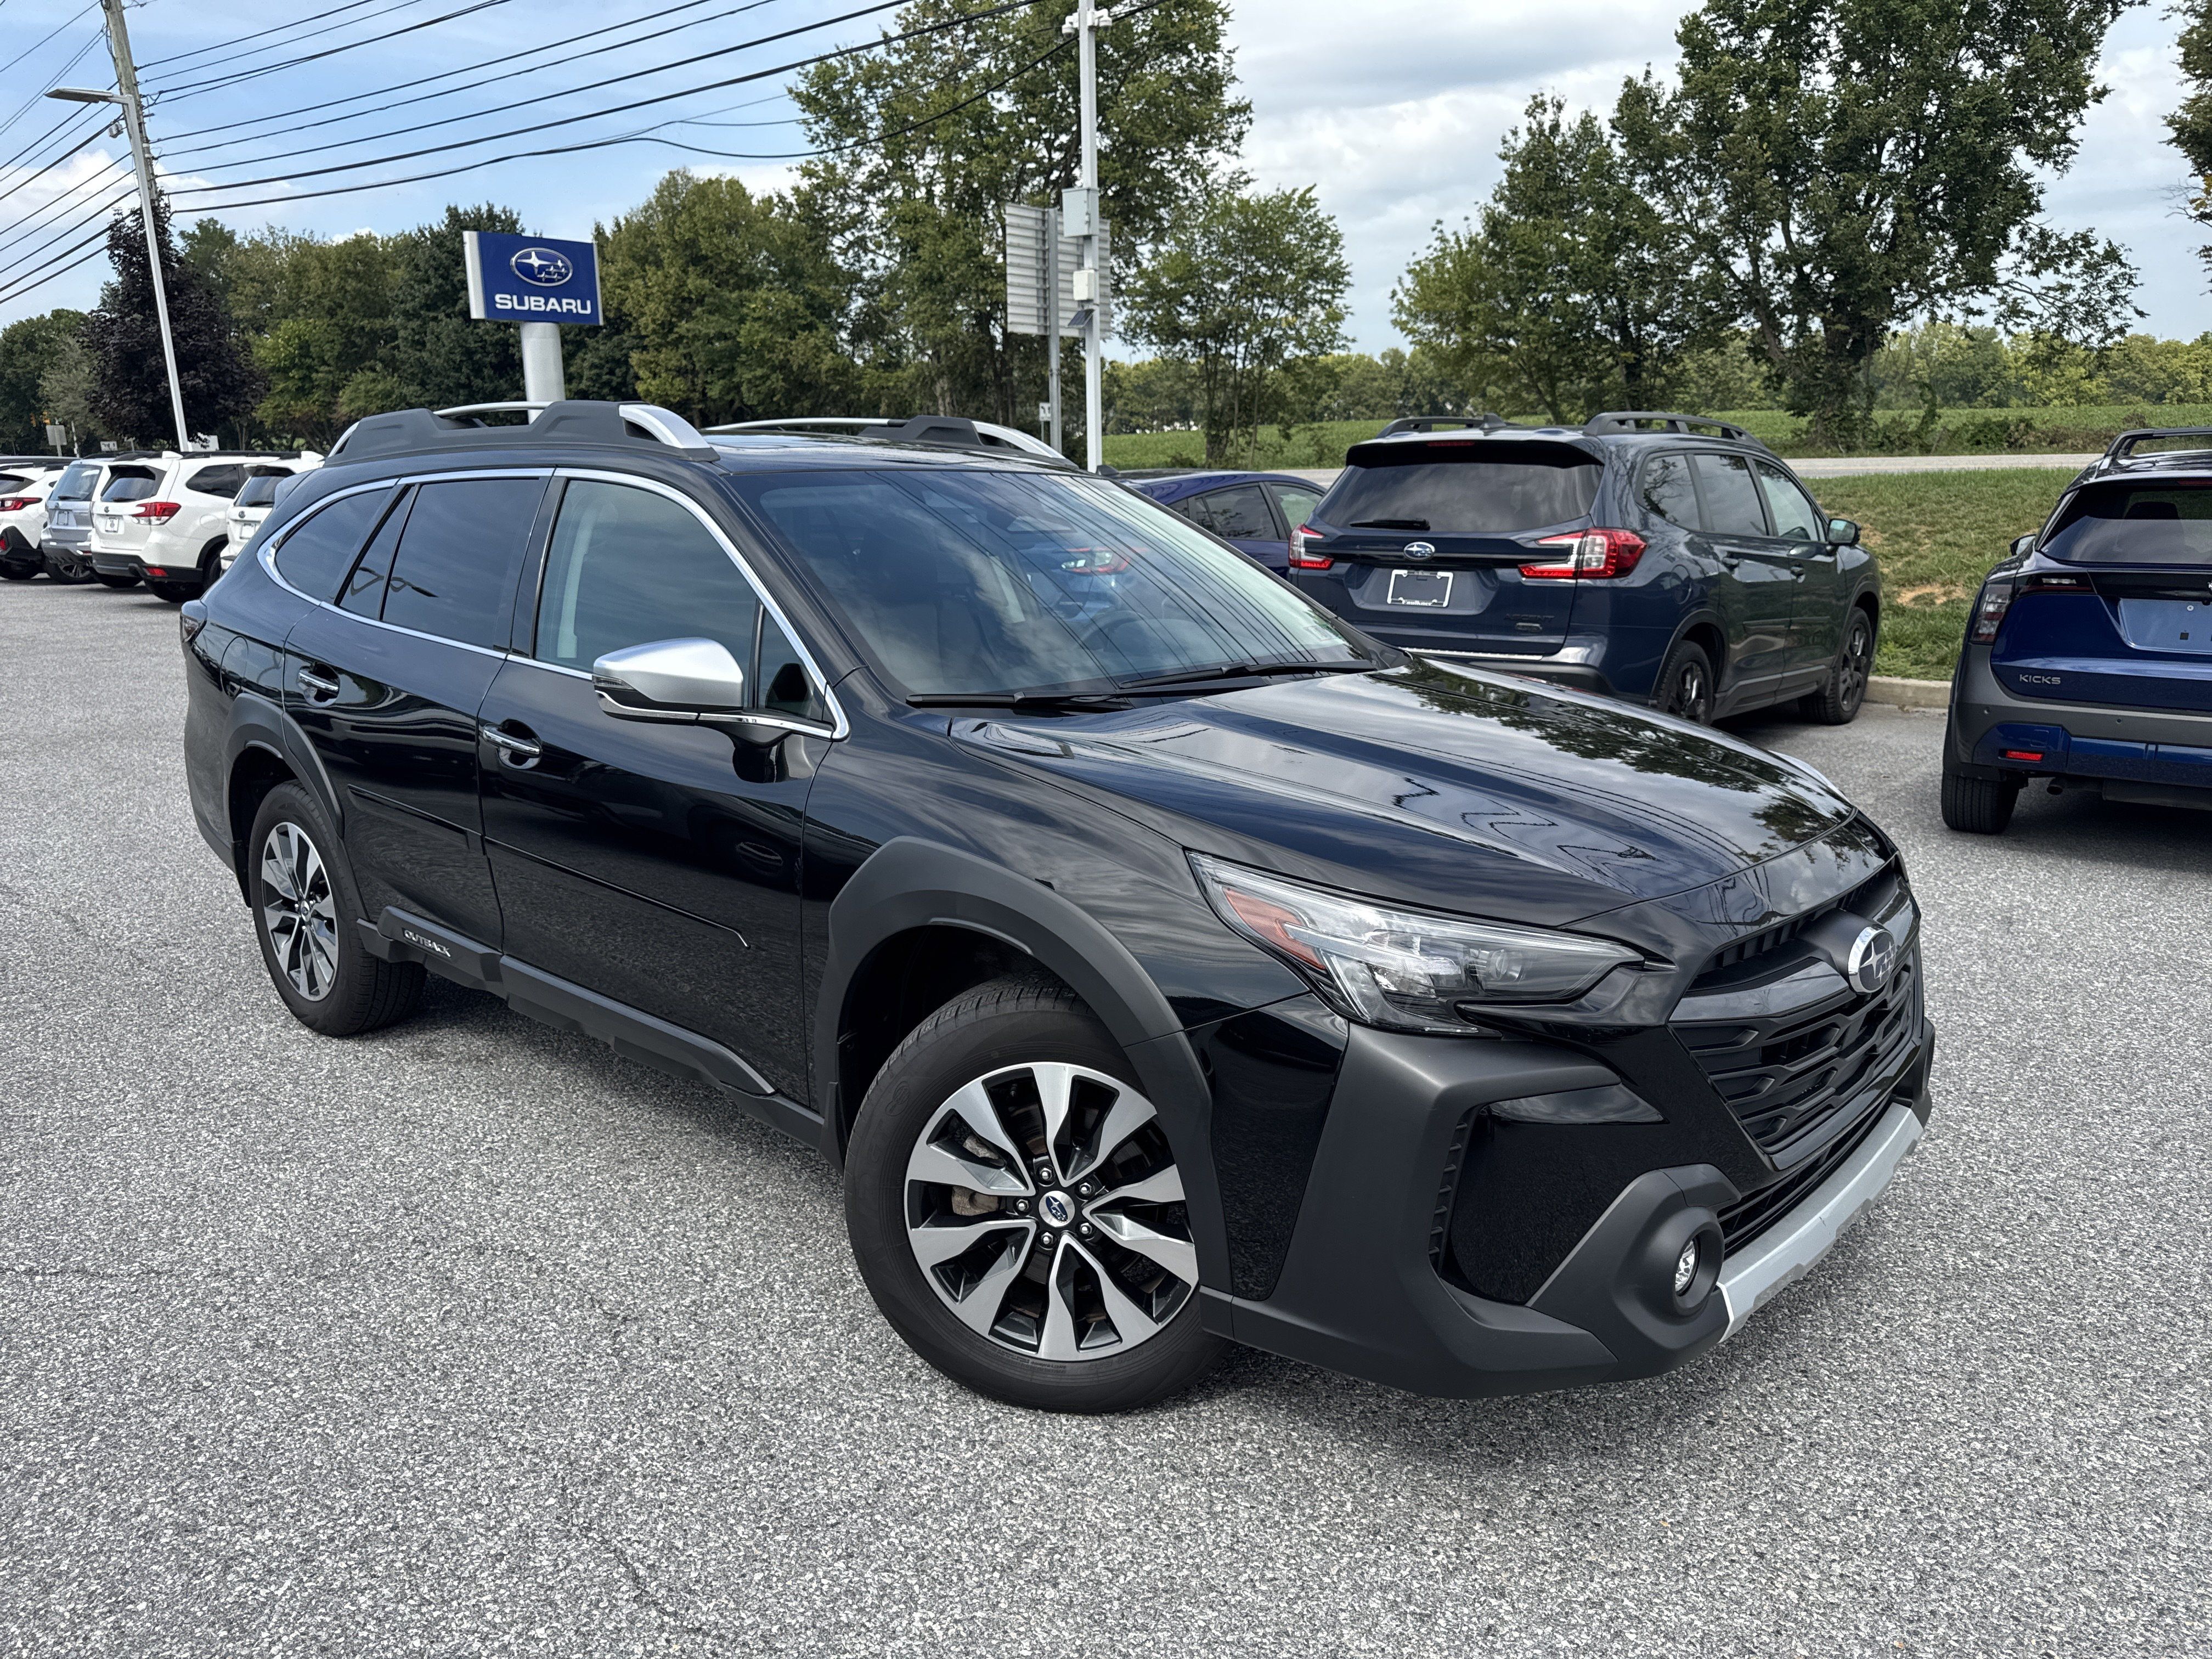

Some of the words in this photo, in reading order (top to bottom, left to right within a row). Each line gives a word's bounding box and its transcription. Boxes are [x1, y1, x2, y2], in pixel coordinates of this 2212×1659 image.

[495, 294, 591, 314] SUBARU
[2019, 673, 2061, 685] KICKS
[404, 929, 452, 957] OUTBACK
